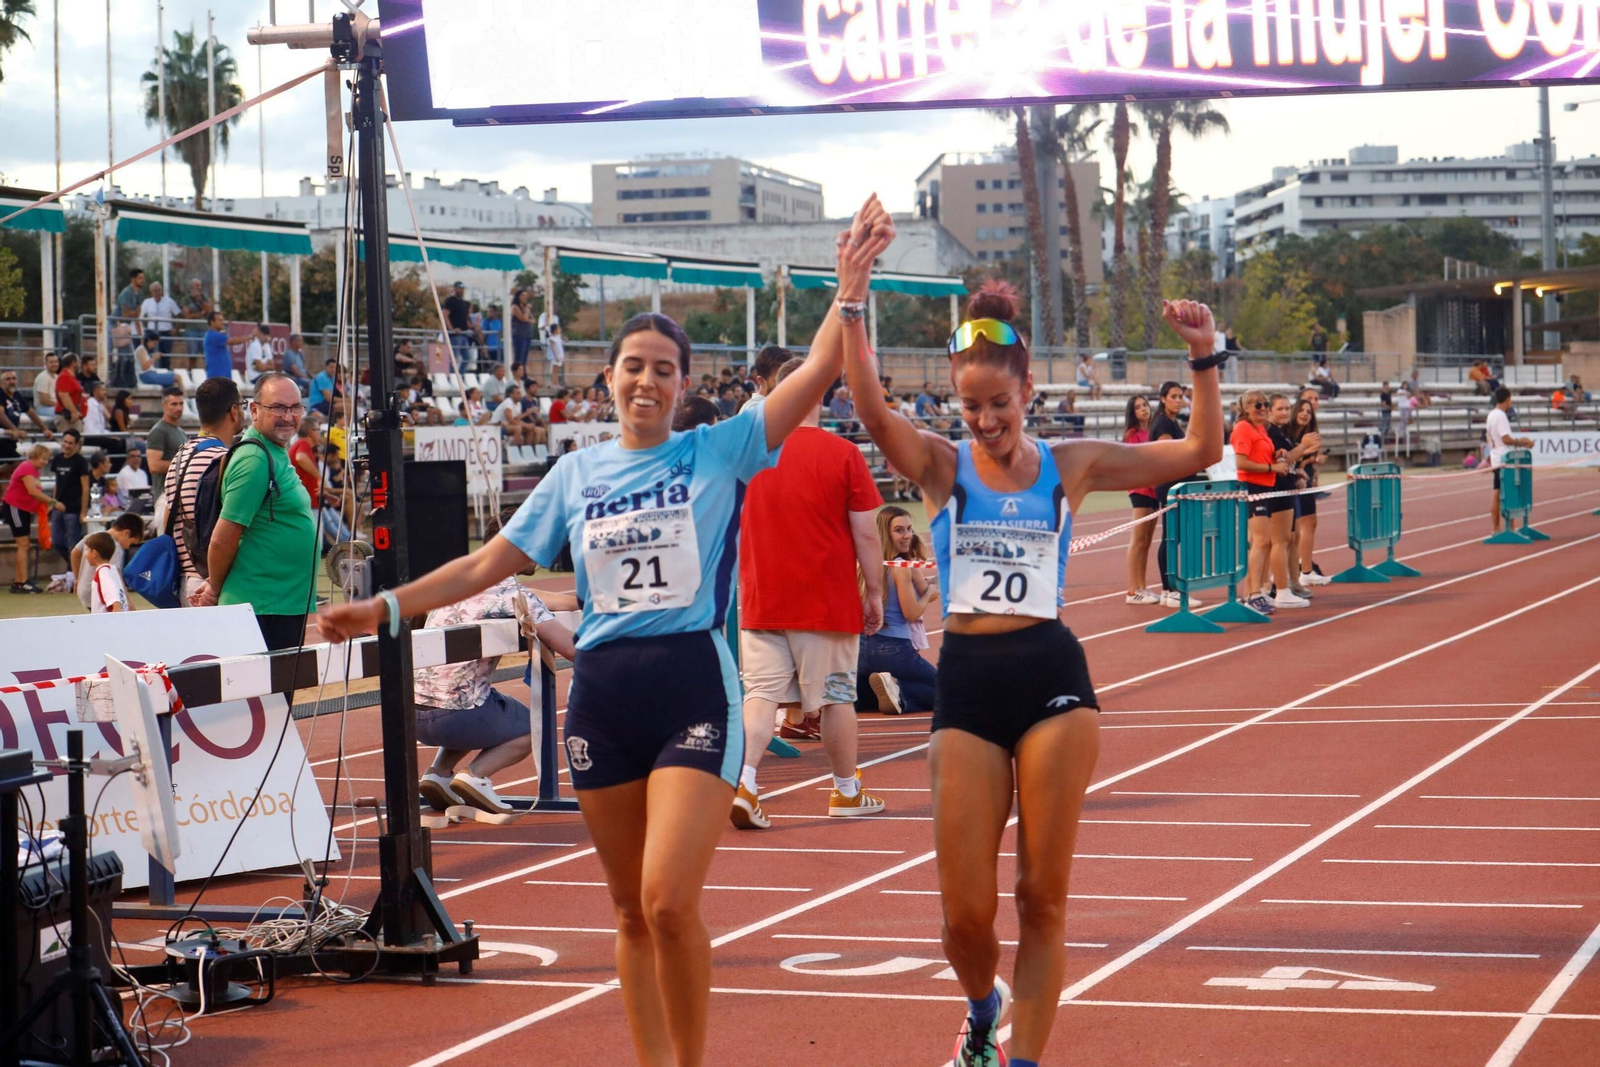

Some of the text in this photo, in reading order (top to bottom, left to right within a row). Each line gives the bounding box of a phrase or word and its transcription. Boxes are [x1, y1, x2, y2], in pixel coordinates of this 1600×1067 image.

[967, 519, 1048, 531] TROTASIERRA
[621, 555, 668, 590] 21
[980, 570, 1028, 603] 20
